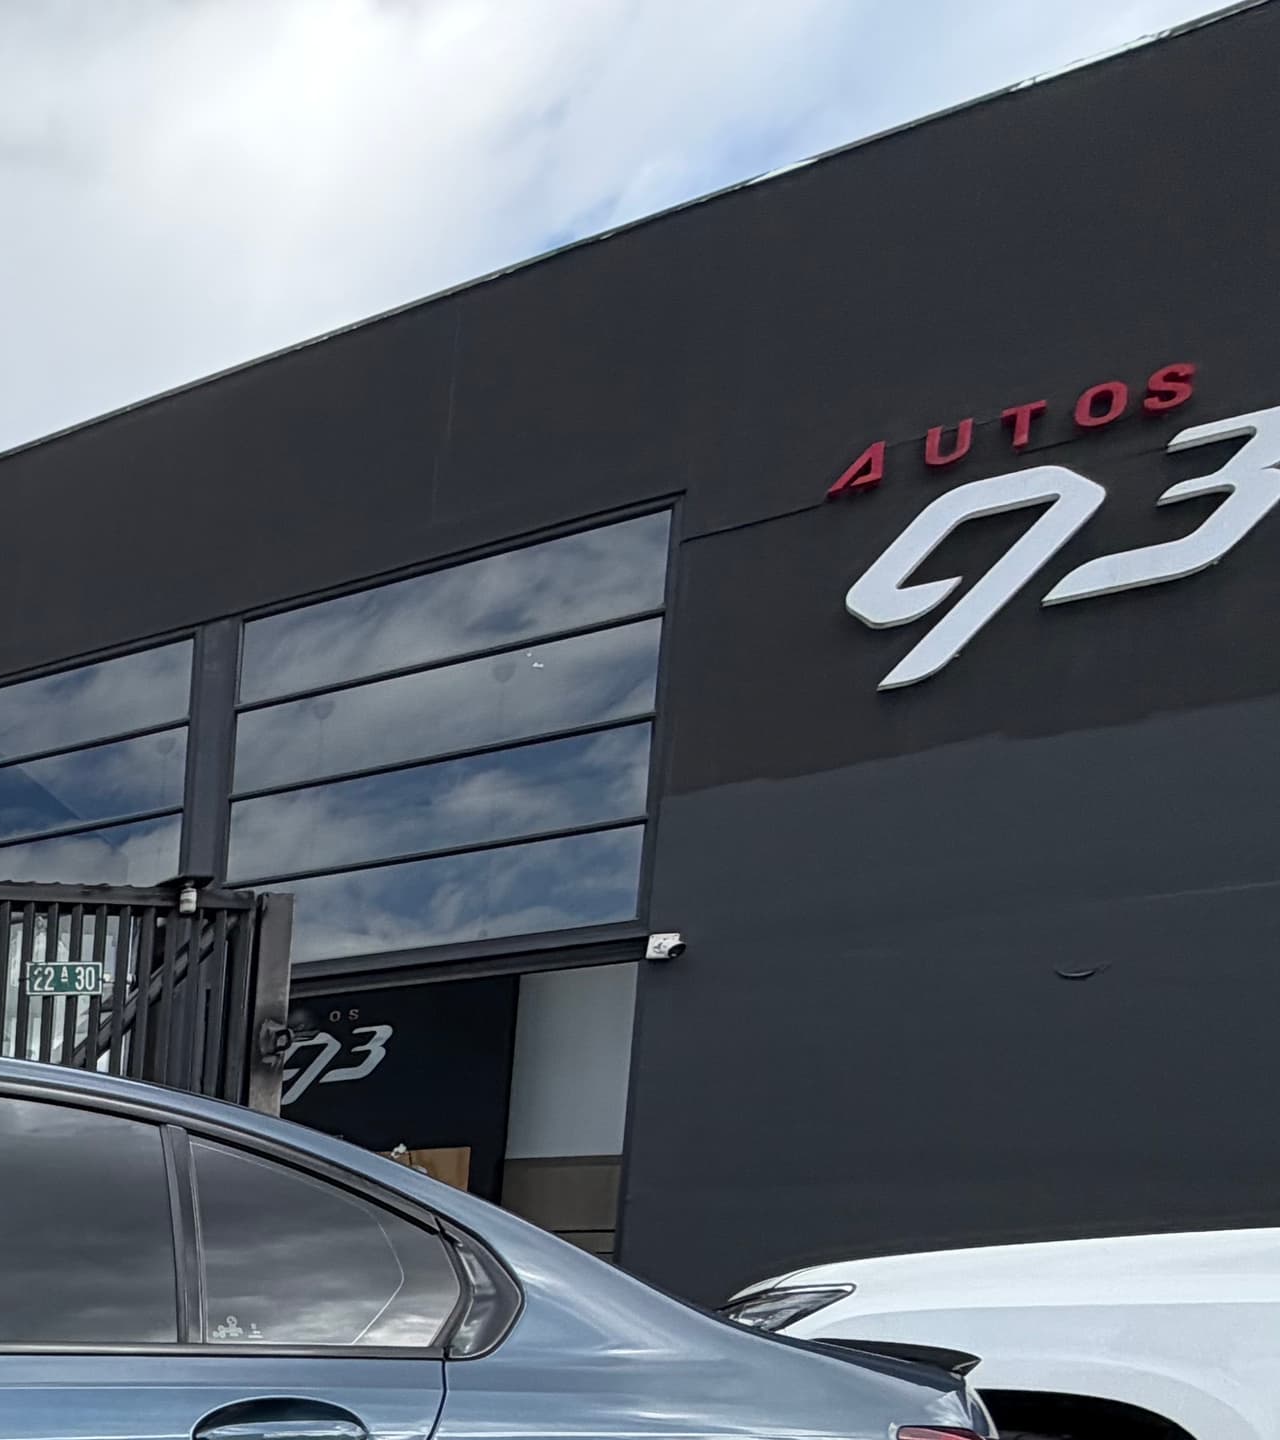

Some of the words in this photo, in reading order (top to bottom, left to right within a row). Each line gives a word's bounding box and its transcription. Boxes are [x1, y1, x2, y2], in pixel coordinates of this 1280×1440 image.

[826, 362, 1197, 500] AUTOS
[845, 406, 1280, 692] 93
[33, 966, 55, 991] 22
[75, 966, 95, 990] 30
